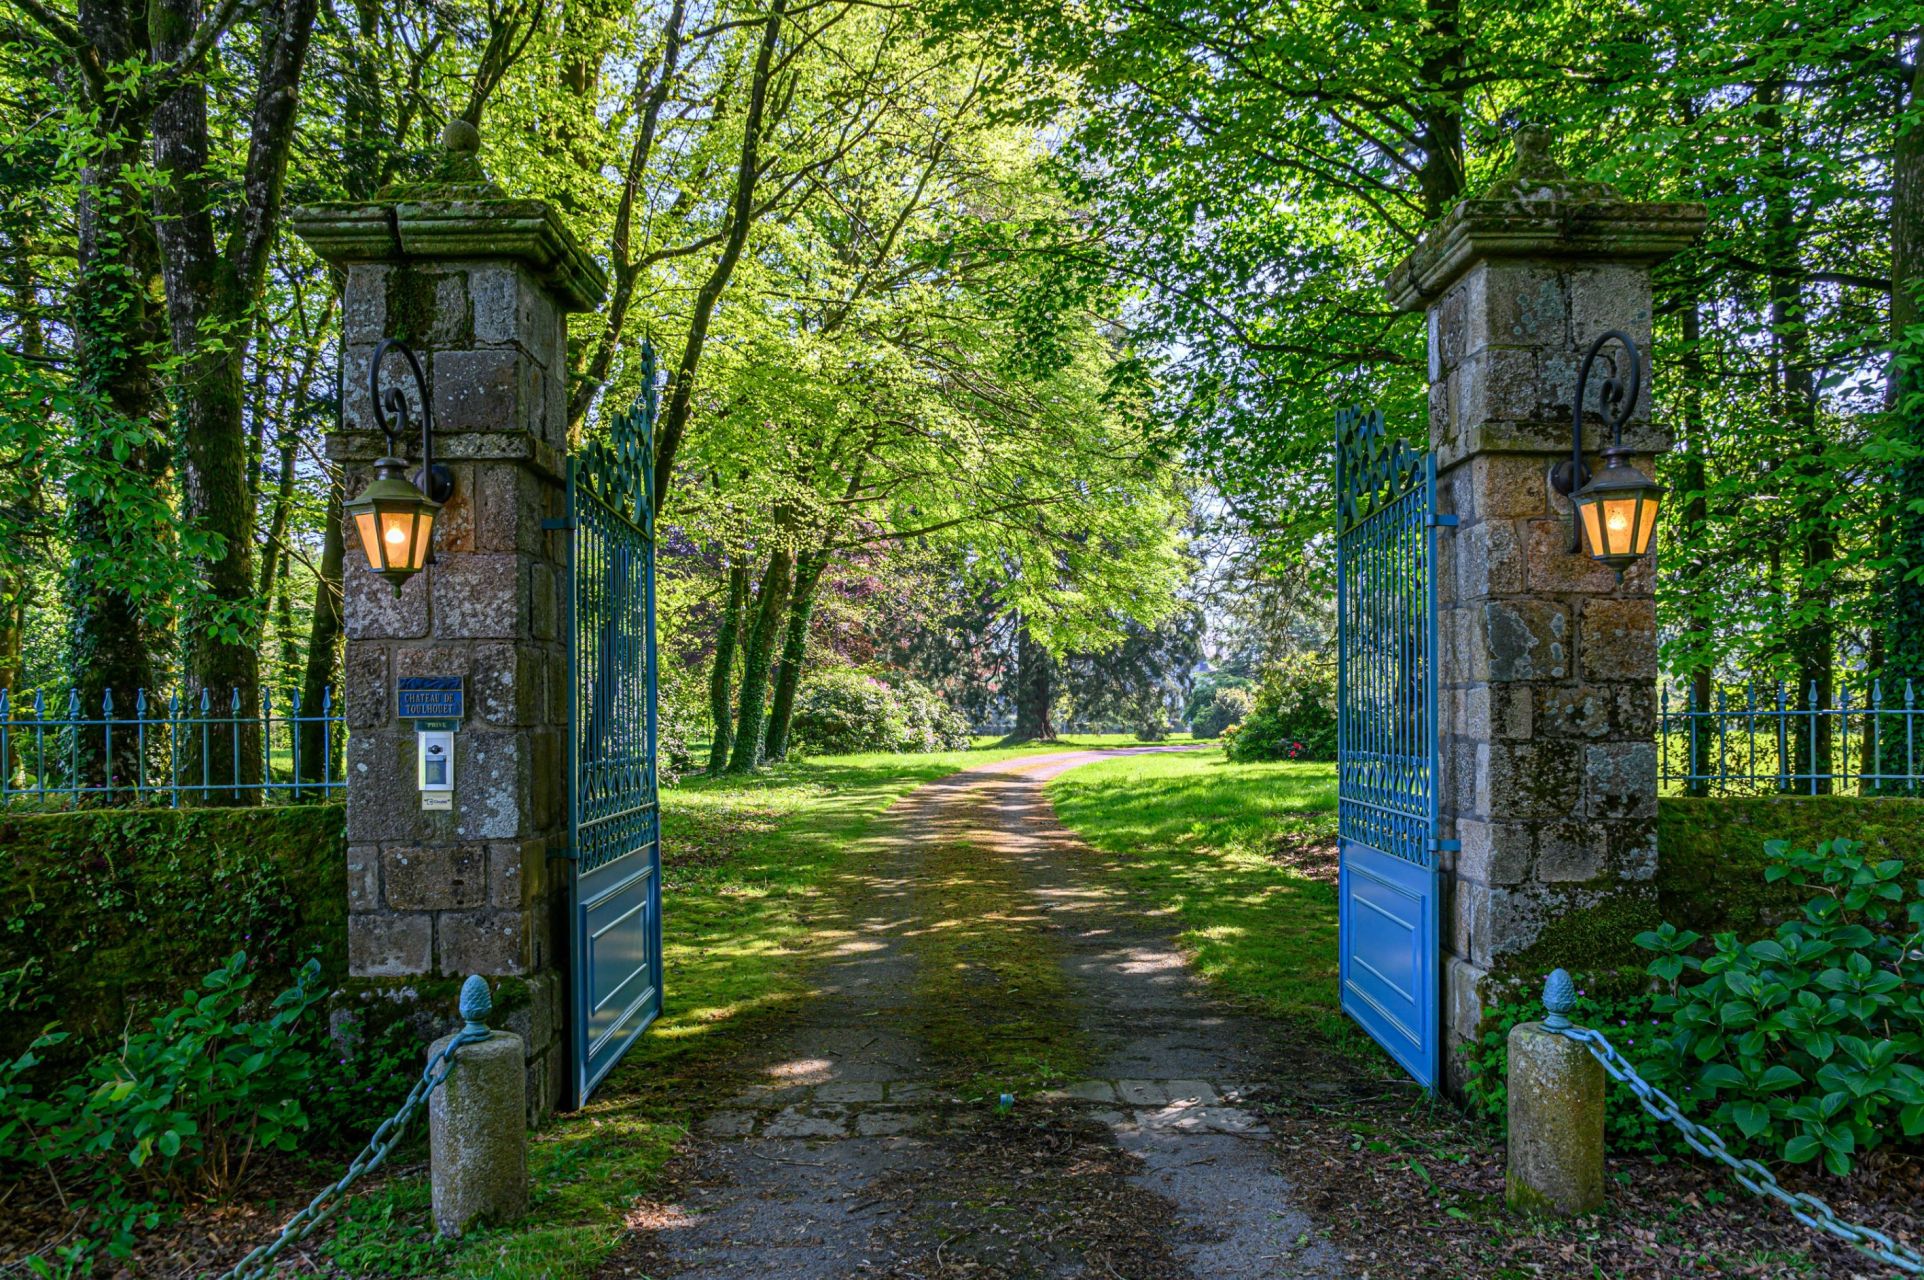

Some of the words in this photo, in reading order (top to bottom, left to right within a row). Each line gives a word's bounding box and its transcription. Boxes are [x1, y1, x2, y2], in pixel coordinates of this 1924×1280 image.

[404, 693, 440, 703] CHATEAU
[444, 693, 454, 703] DE
[404, 704, 453, 714] TOULHOUET
